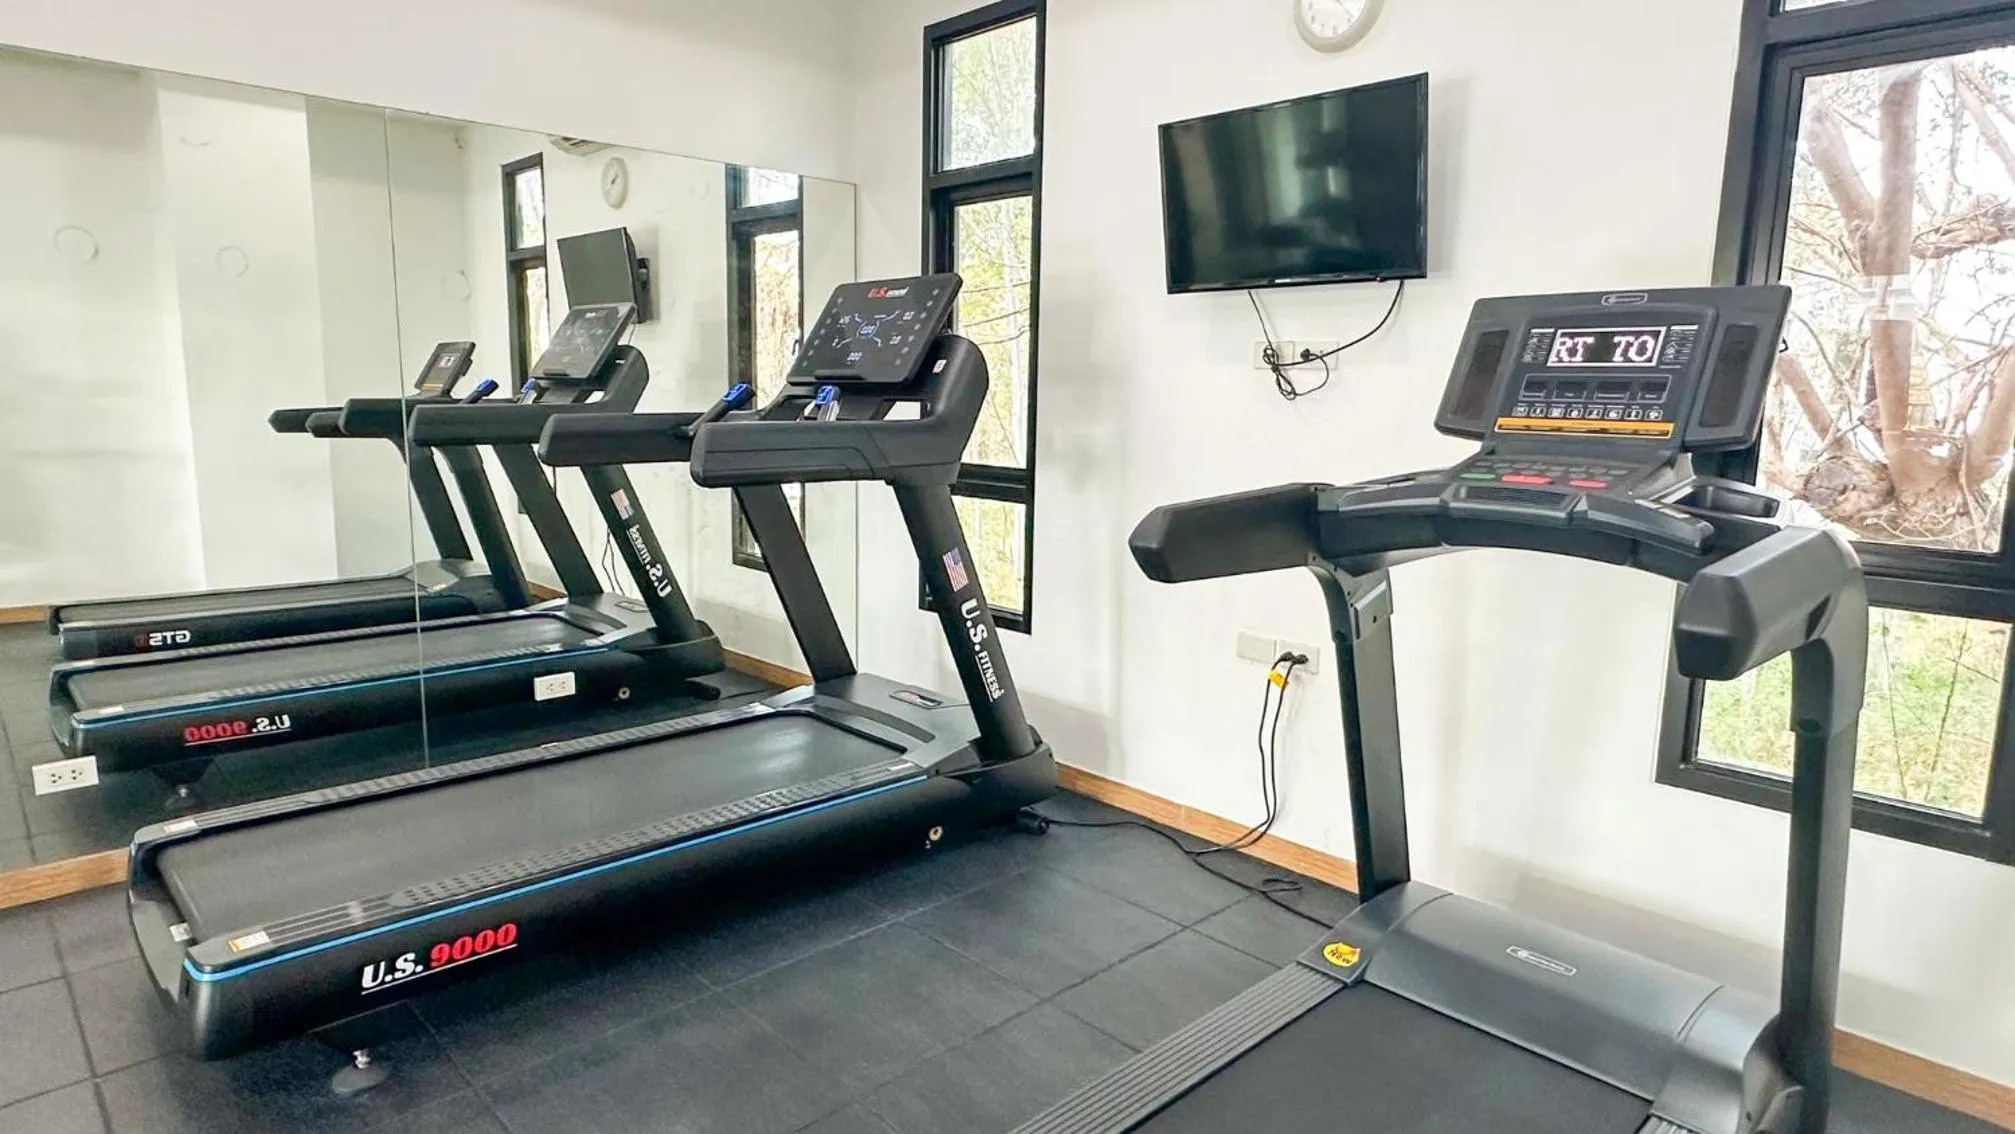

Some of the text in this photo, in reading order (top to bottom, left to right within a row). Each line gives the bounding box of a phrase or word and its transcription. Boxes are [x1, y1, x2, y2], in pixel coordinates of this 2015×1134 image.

[1551, 336, 1594, 362] RT
[1612, 335, 1656, 362] TO
[960, 599, 1004, 700] U.S. FITNESS
[361, 923, 518, 988] U.S. 9000
